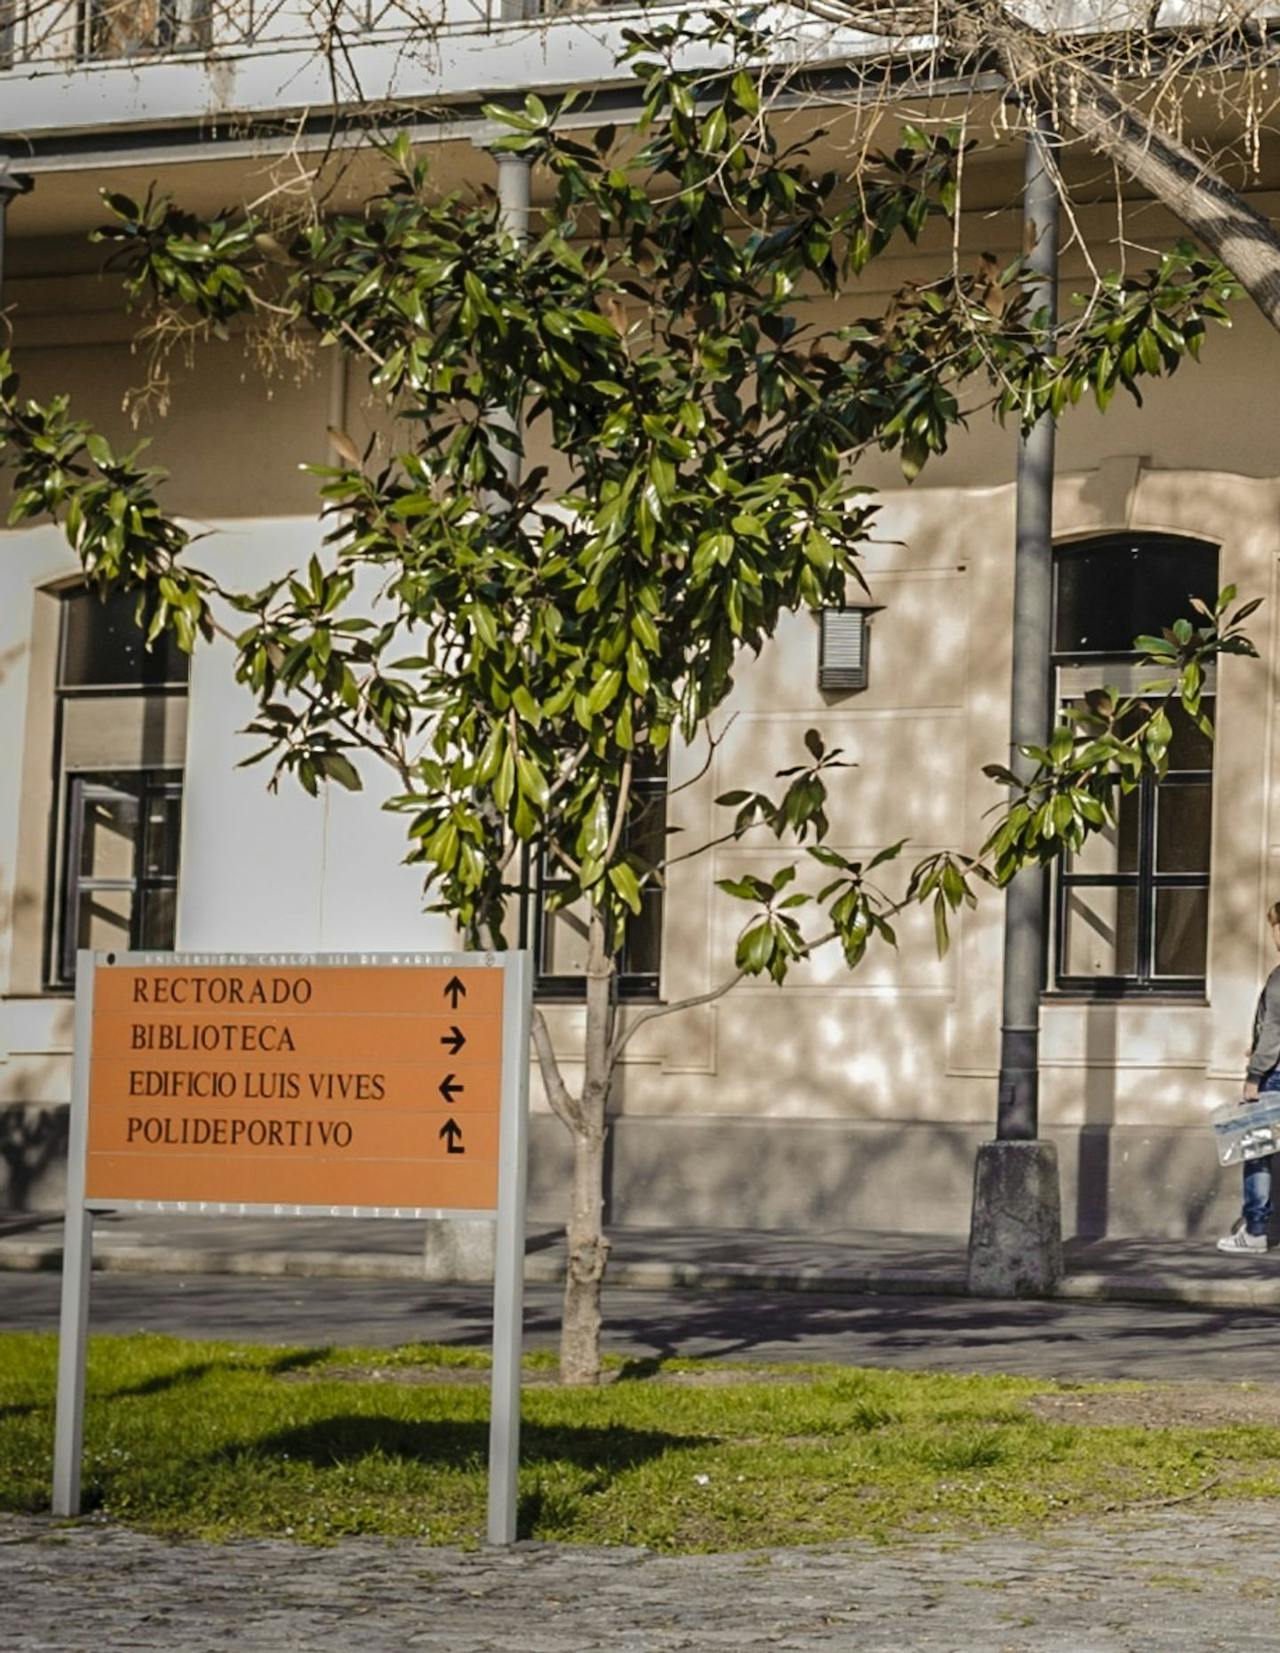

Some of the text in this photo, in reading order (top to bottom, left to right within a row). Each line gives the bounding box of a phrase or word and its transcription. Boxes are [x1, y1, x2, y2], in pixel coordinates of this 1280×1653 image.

[145, 954, 453, 966] UNIVERSIDAD CARLOS III DE MADRID
[133, 978, 312, 1003] RECTORADO
[131, 1024, 295, 1051] BIBLIOTECA
[129, 1070, 386, 1100] EDIFICIO LUIS VIVES
[127, 1117, 353, 1147] POLIDEPORTIVO
[136, 1201, 443, 1219] CAMPUS DE GETAFE
